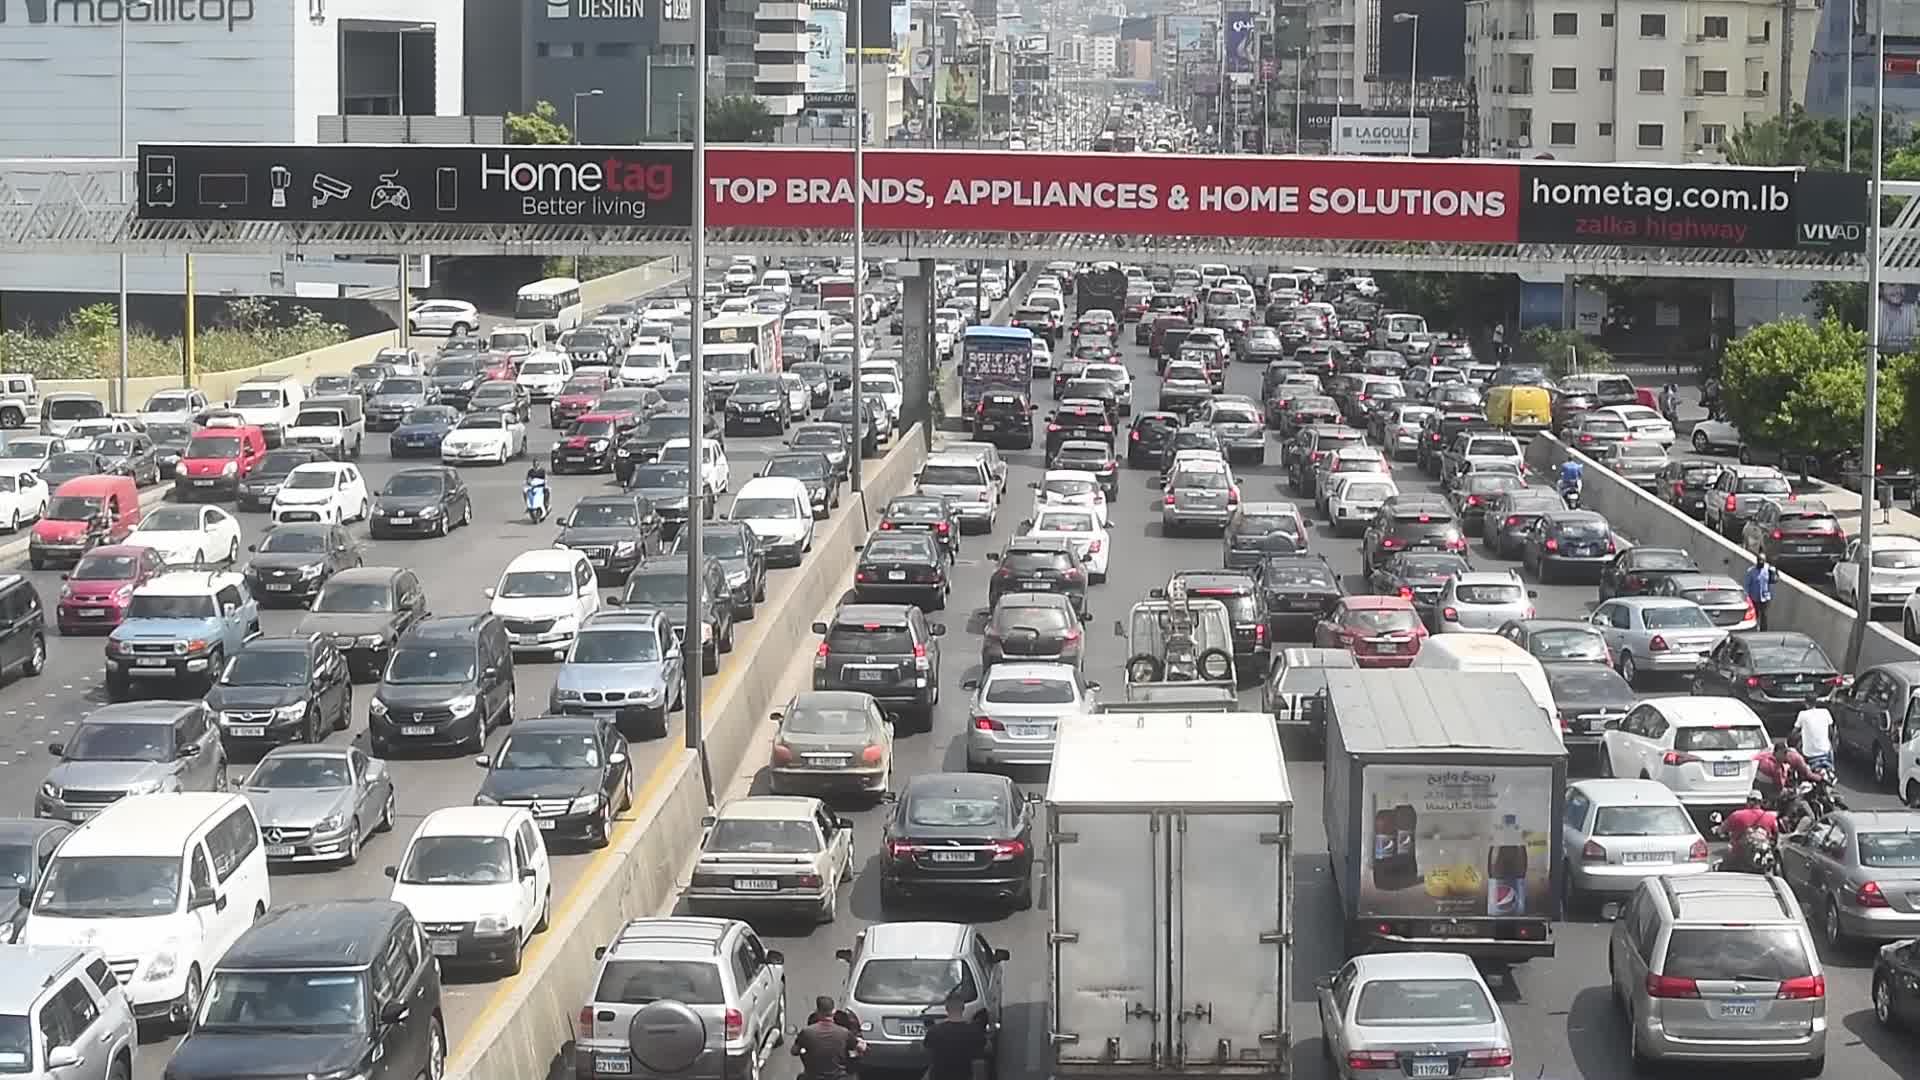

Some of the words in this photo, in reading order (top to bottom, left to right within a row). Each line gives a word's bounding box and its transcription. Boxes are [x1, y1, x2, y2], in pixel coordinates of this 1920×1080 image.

[578, 0, 644, 18] DESIGN
[481, 152, 673, 200] Hometag
[522, 196, 586, 216] Better
[592, 196, 646, 218] living
[709, 178, 777, 203] TOP
[786, 179, 934, 208] BRANDS,
[944, 180, 1158, 209] APPLIANCES
[1168, 185, 1189, 210] &
[1200, 186, 1299, 212] HOME
[1309, 188, 1506, 217] SOLUTIONS
[1532, 178, 1790, 211] hometag.com.lb
[1575, 215, 1637, 235] zalka
[1646, 215, 1748, 243] highway
